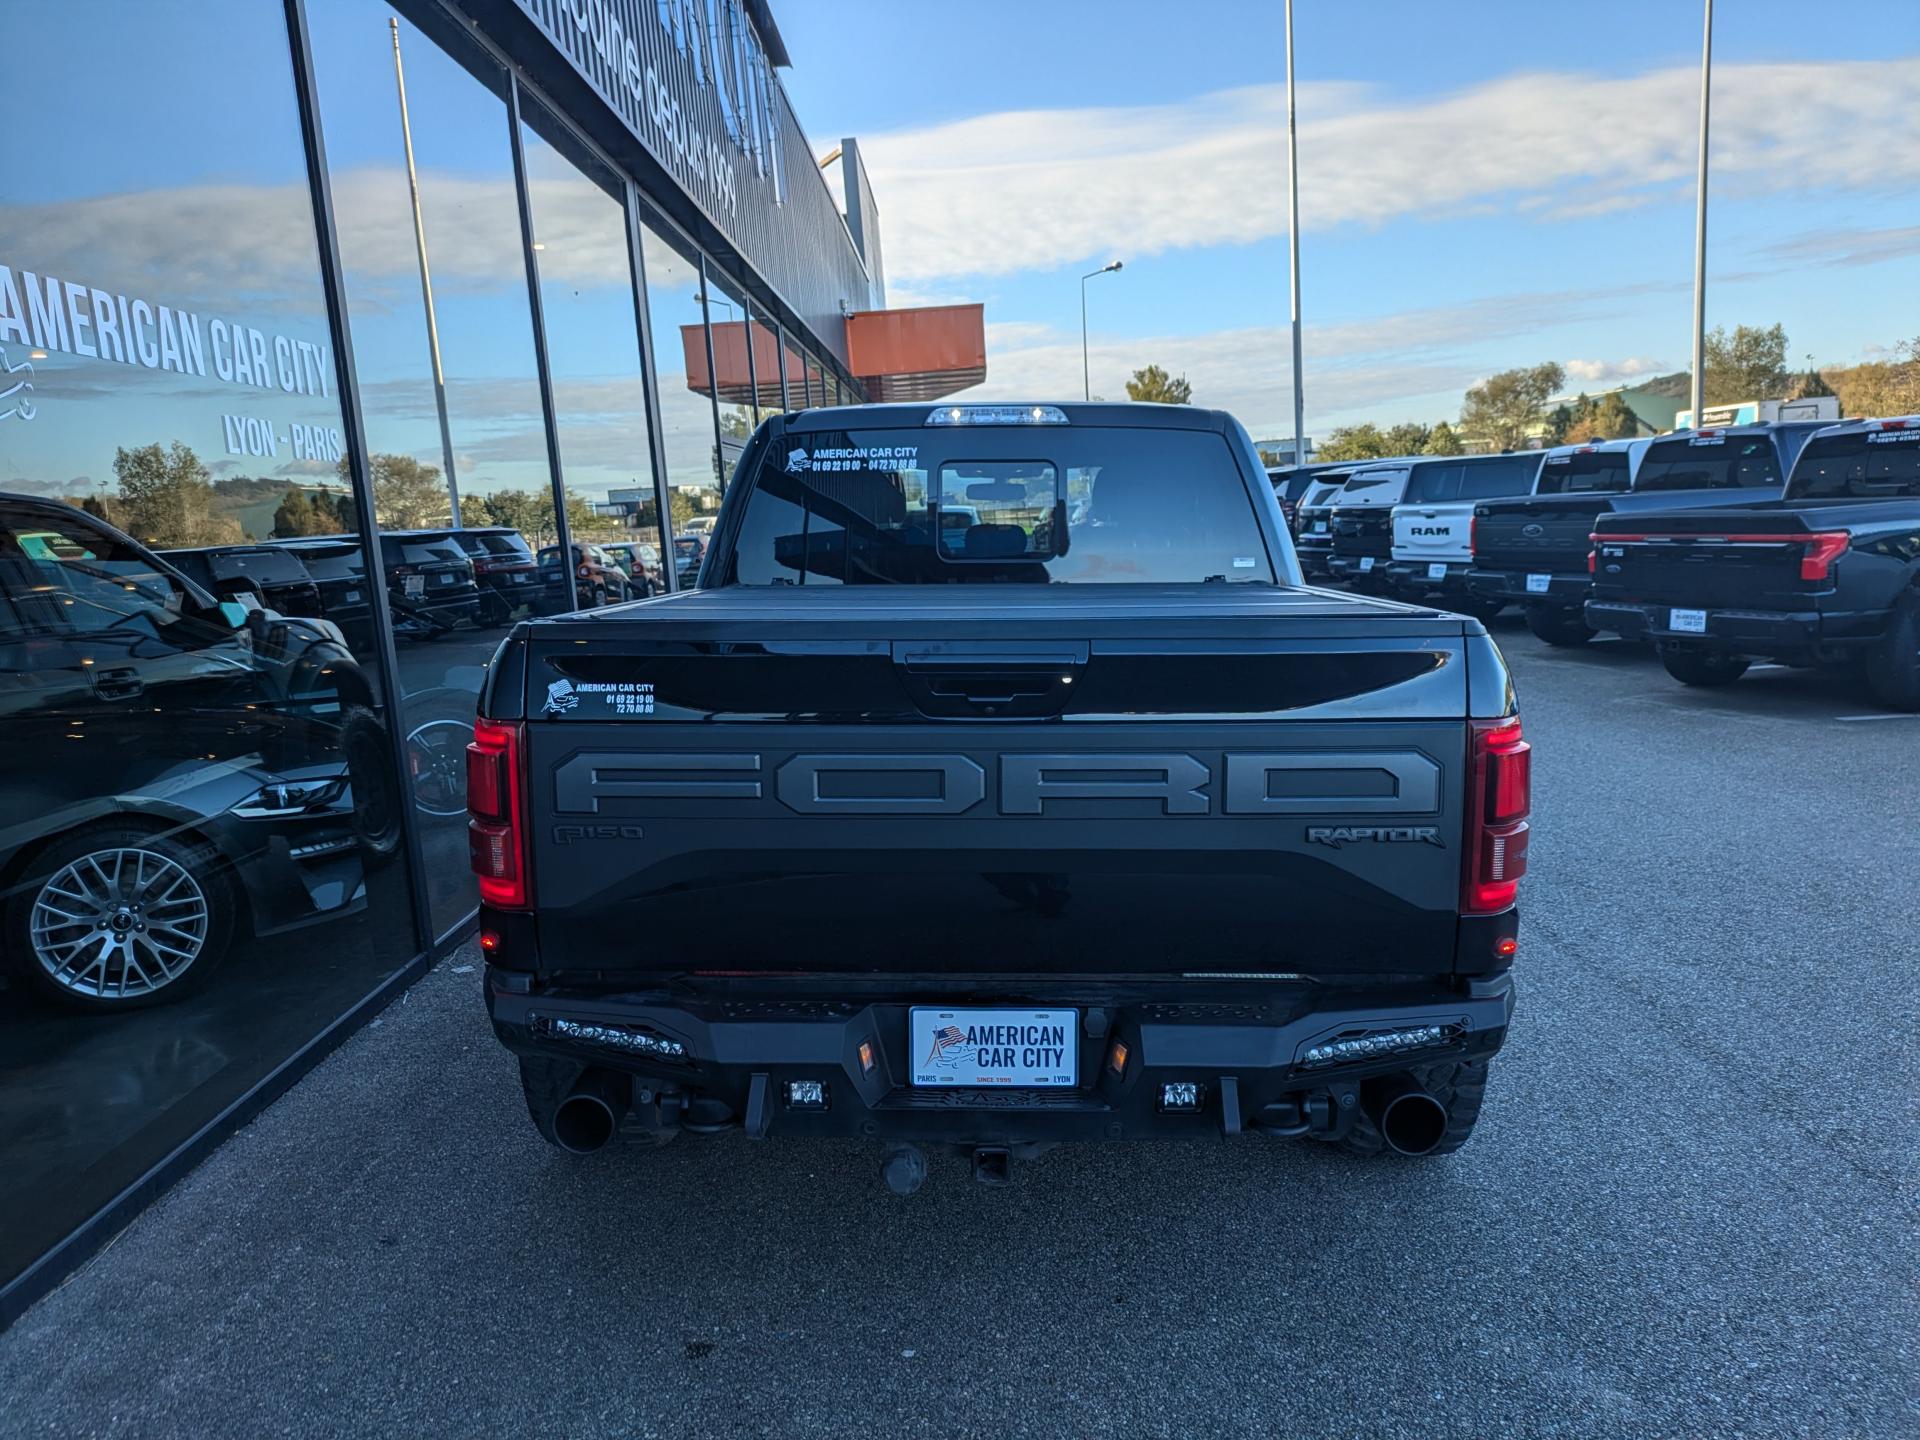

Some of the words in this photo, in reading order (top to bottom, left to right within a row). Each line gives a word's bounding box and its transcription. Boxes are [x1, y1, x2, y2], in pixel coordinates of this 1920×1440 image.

[706, 134, 736, 218] 1999
[0, 264, 206, 376] AMERICAN
[209, 319, 272, 388] CAR
[274, 335, 329, 398] CITY
[221, 414, 277, 457] LYON
[290, 424, 342, 462] PARIS
[813, 449, 868, 459] AMERICAN
[869, 449, 893, 458] CAR
[894, 447, 918, 457] CITY
[812, 461, 821, 471] 01
[822, 461, 831, 471] 69
[832, 461, 840, 471] 22
[842, 461, 851, 471] 19
[852, 460, 861, 471] 00
[869, 460, 879, 470] 04
[879, 460, 888, 470] 72
[889, 459, 897, 469] 70
[1411, 527, 1450, 536] RAM
[576, 684, 617, 692] AMERICAN
[618, 684, 635, 692] CAR
[636, 684, 654, 692] CITY
[606, 695, 615, 704] 01
[616, 695, 625, 704] 69
[626, 695, 634, 704] 22
[636, 695, 644, 704] 19
[645, 695, 654, 704] 00
[616, 704, 625, 714] 72
[626, 704, 635, 714] 70
[554, 750, 1441, 816] FORD
[1307, 824, 1445, 849] RAPTOR
[966, 1025, 1065, 1046] AMERICAN
[977, 1047, 1017, 1068] CAR
[1022, 1047, 1065, 1068] CITY
[917, 1075, 937, 1083] PARIS
[1053, 1075, 1071, 1083] LYON
